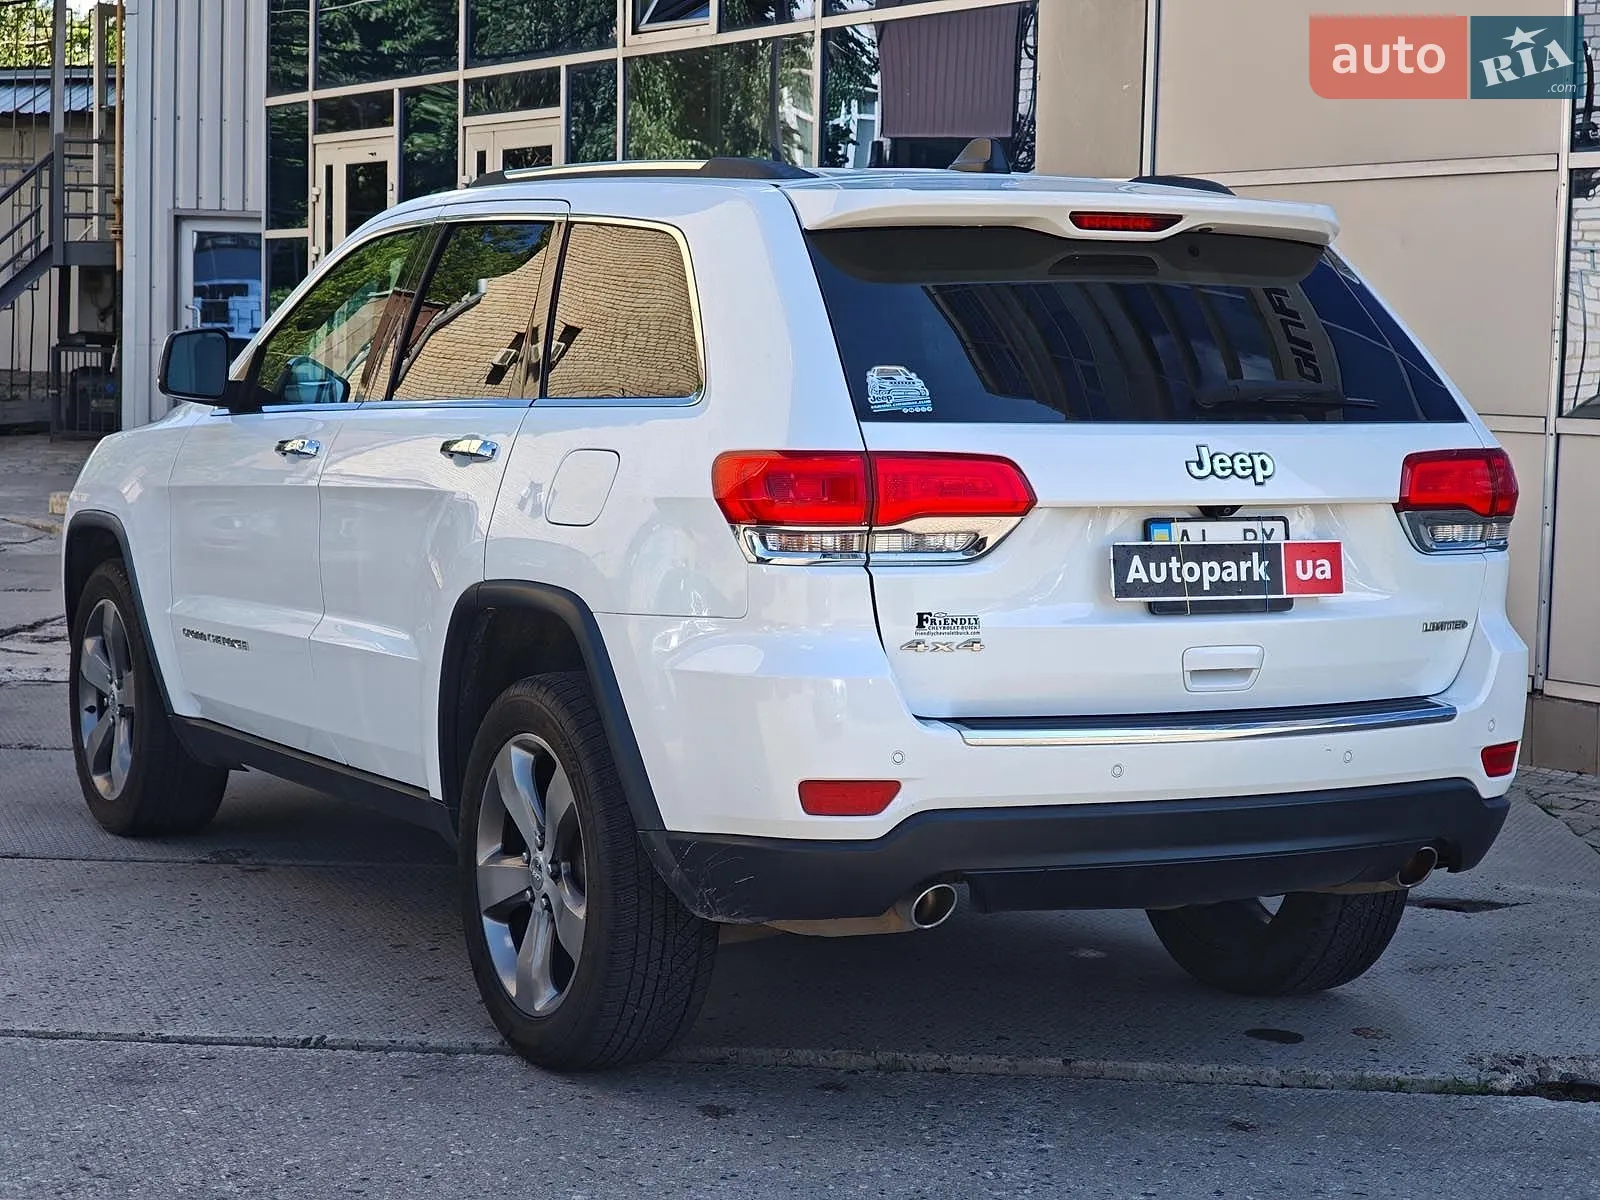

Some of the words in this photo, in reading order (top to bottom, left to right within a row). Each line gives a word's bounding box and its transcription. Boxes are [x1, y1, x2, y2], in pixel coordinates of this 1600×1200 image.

[1185, 445, 1275, 485] Jeep
[1126, 551, 1270, 591] Autopark
[1295, 559, 1332, 581] ua
